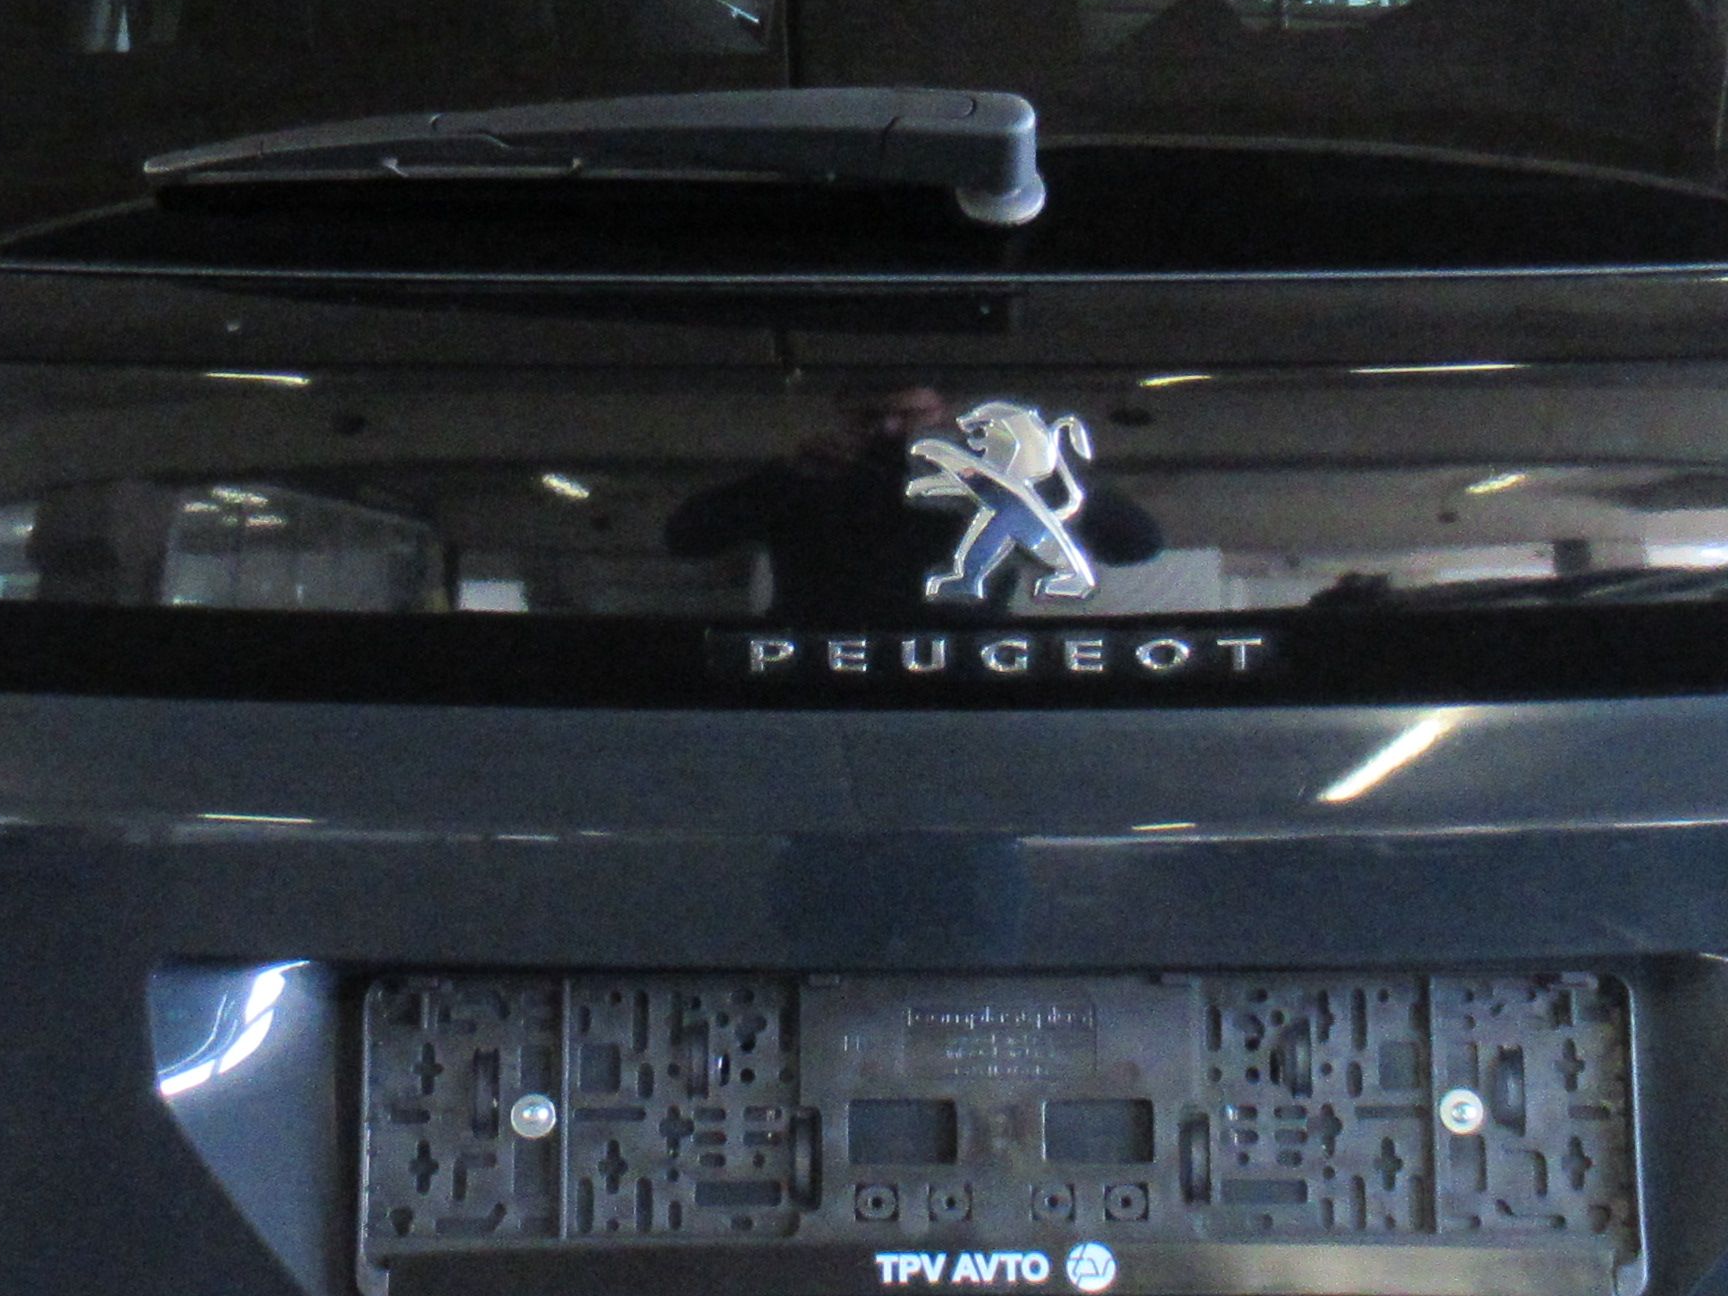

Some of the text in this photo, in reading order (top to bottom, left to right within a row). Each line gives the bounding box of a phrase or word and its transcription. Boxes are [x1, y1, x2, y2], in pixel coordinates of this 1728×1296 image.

[749, 638, 1263, 673] PEUGEOT
[875, 1253, 1052, 1284] TPV AVTO
